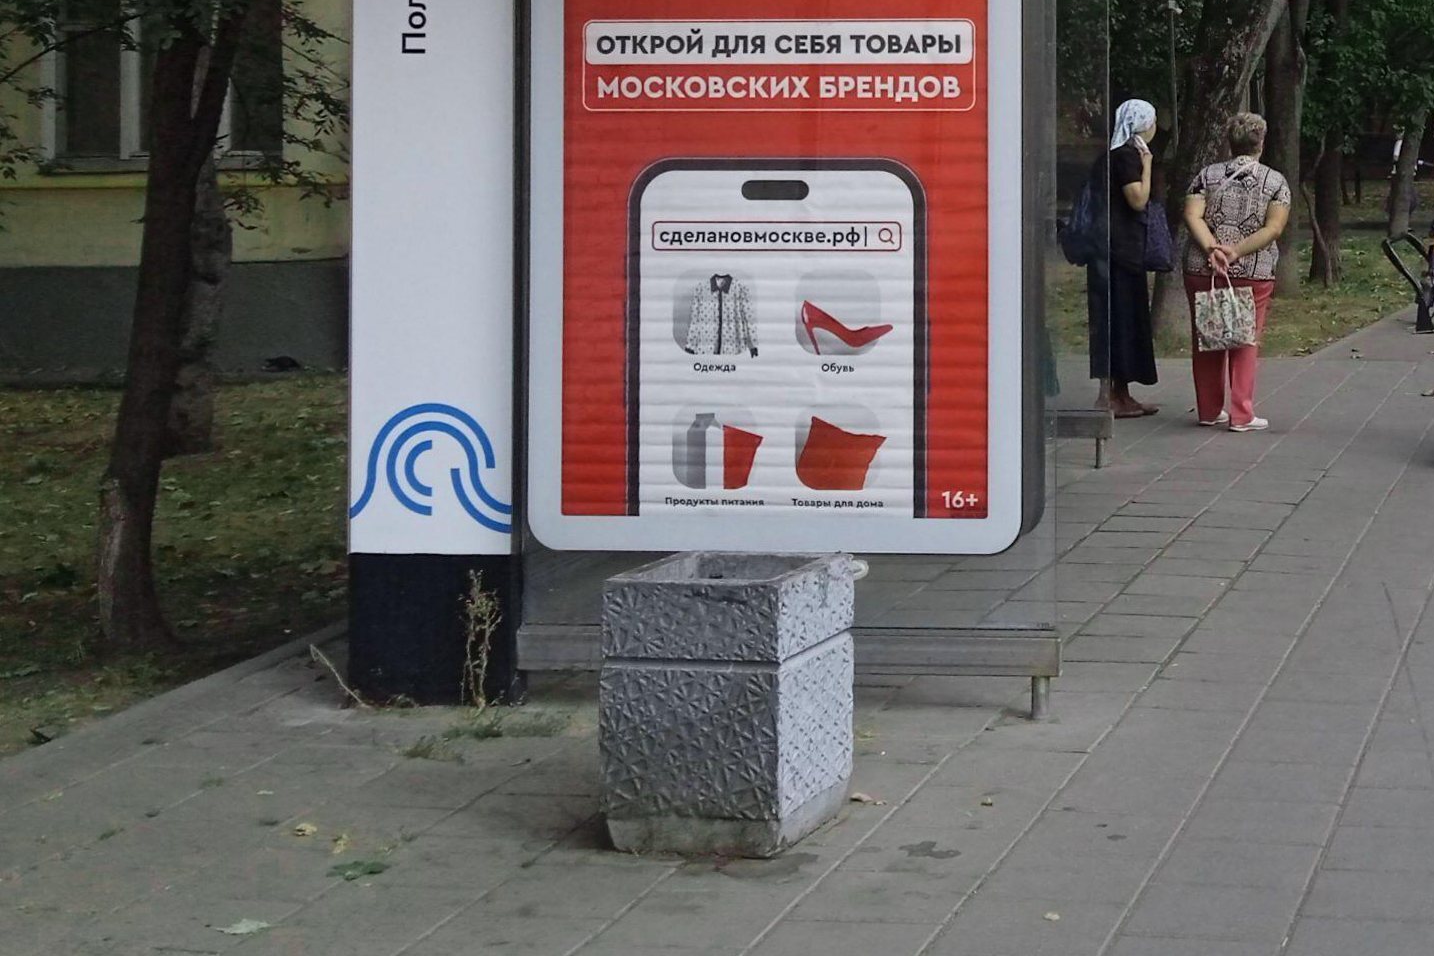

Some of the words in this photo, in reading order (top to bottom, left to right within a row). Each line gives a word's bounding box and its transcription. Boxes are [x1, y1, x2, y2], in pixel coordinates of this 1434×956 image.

[596, 28, 704, 54] ОТКРОЙ
[712, 35, 766, 58] ДЛЯ
[774, 34, 842, 54] СЕБЯ
[850, 34, 961, 54] ТОВАРЫ
[597, 75, 810, 99] МОСКОВСКИХ
[819, 75, 961, 102] БРЕНДОВ
[693, 362, 736, 373] Одежда
[821, 363, 855, 374] Обувь
[665, 497, 719, 507] Продукты
[791, 498, 831, 508] Товары
[834, 499, 853, 508] для
[856, 500, 884, 508] дома
[941, 491, 979, 509] 16+
